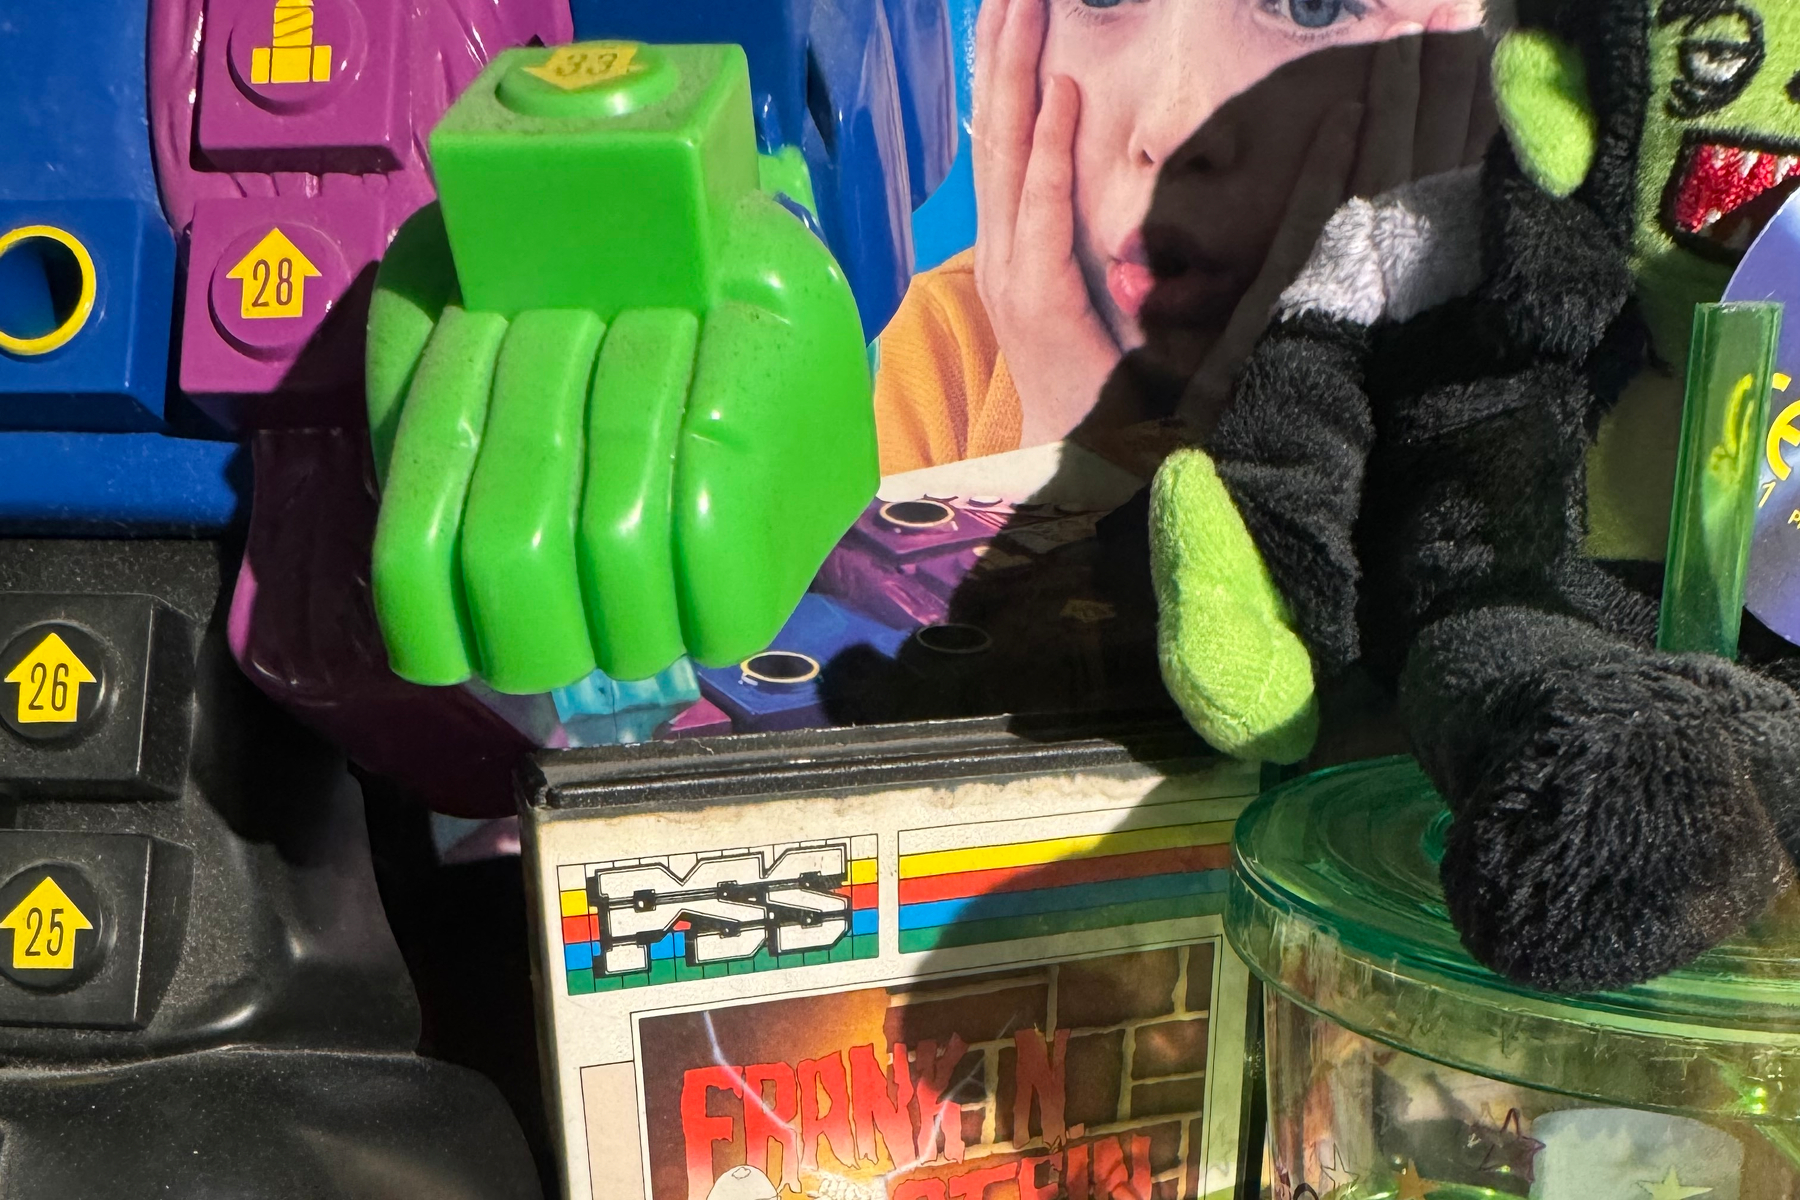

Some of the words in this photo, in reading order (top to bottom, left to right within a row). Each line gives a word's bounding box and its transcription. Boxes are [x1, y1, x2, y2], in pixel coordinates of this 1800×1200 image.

[251, 256, 293, 308] 28
[28, 662, 69, 712] 26
[24, 906, 65, 957] 25
[586, 842, 851, 979] PSS
